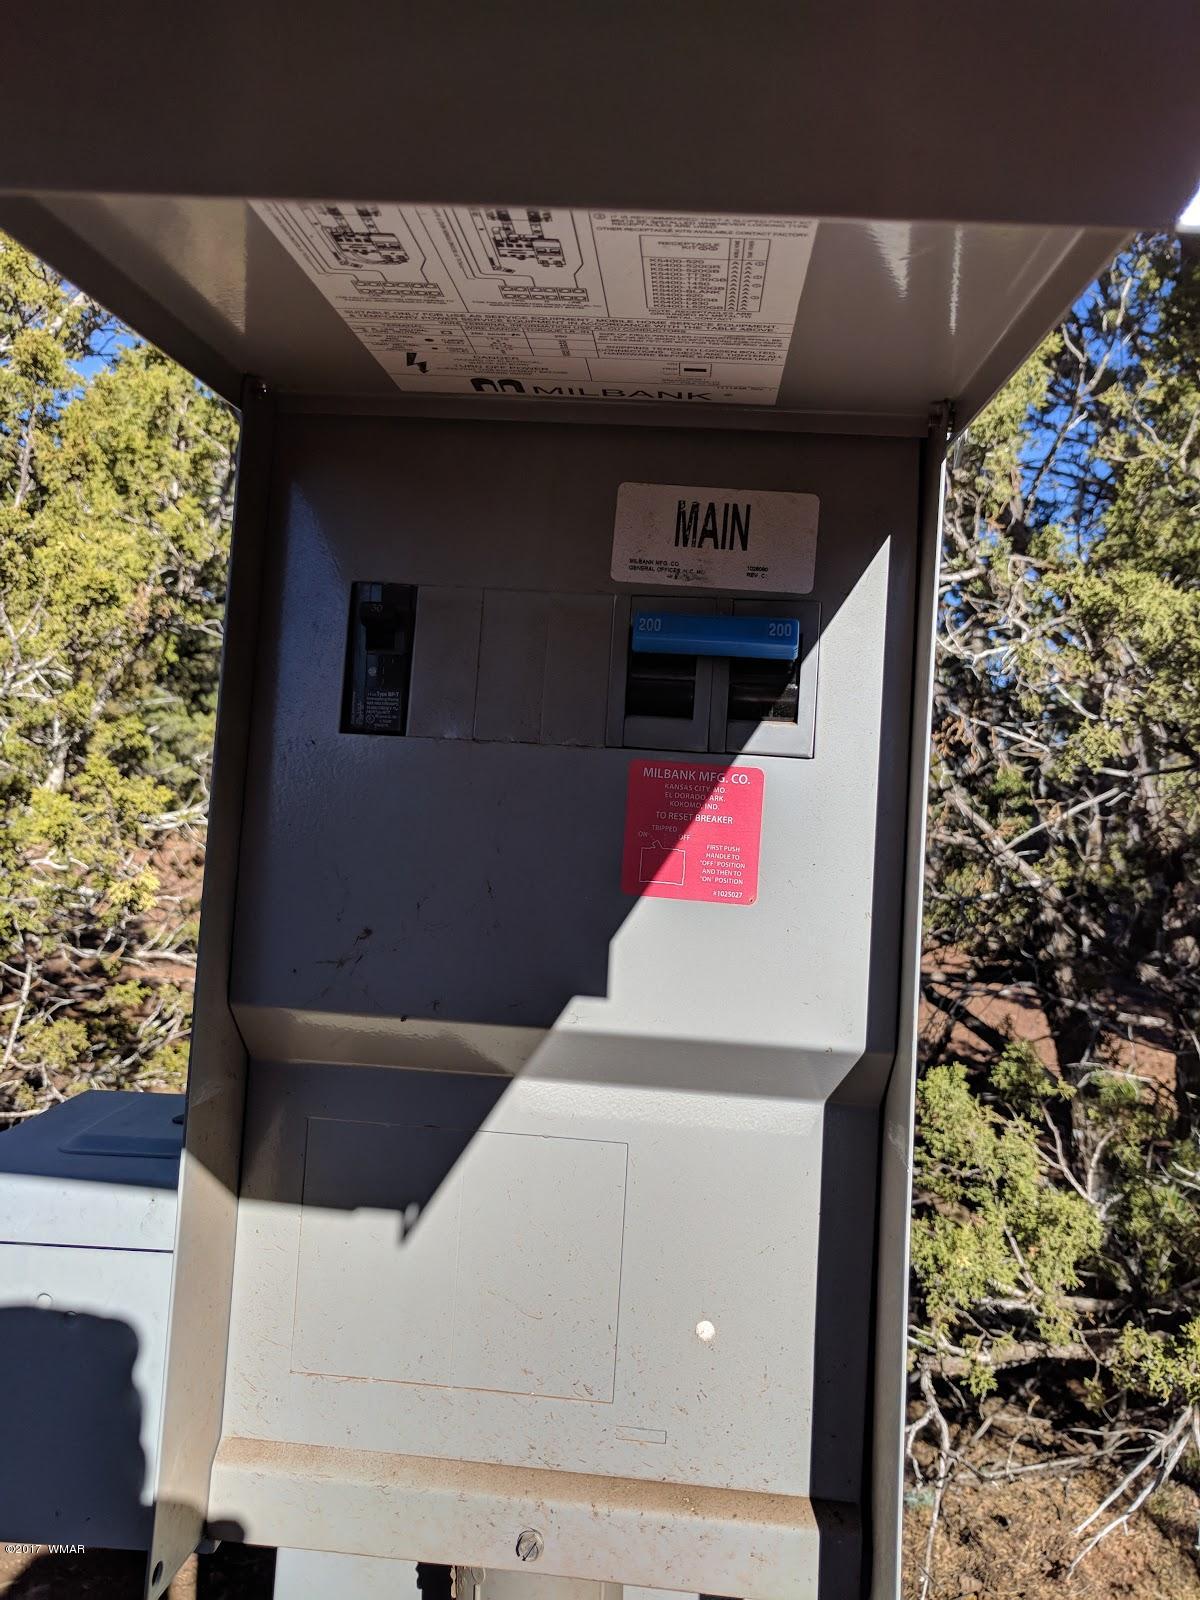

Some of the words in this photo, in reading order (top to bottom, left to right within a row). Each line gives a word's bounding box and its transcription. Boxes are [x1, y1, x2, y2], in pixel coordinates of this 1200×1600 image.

[533, 386, 713, 400] MILBANK
[674, 500, 751, 551] MAIN
[639, 618, 662, 631] 200
[769, 623, 792, 636] 200
[643, 767, 696, 780] MILBANK
[699, 773, 728, 784] MFG.
[731, 774, 751, 786] CO.
[665, 784, 693, 792] KANSAS
[656, 811, 666, 819] TO
[668, 812, 693, 822] RESET
[695, 814, 734, 825] BREAKER
[717, 869, 733, 877] THEN
[715, 877, 743, 885] POSITION
